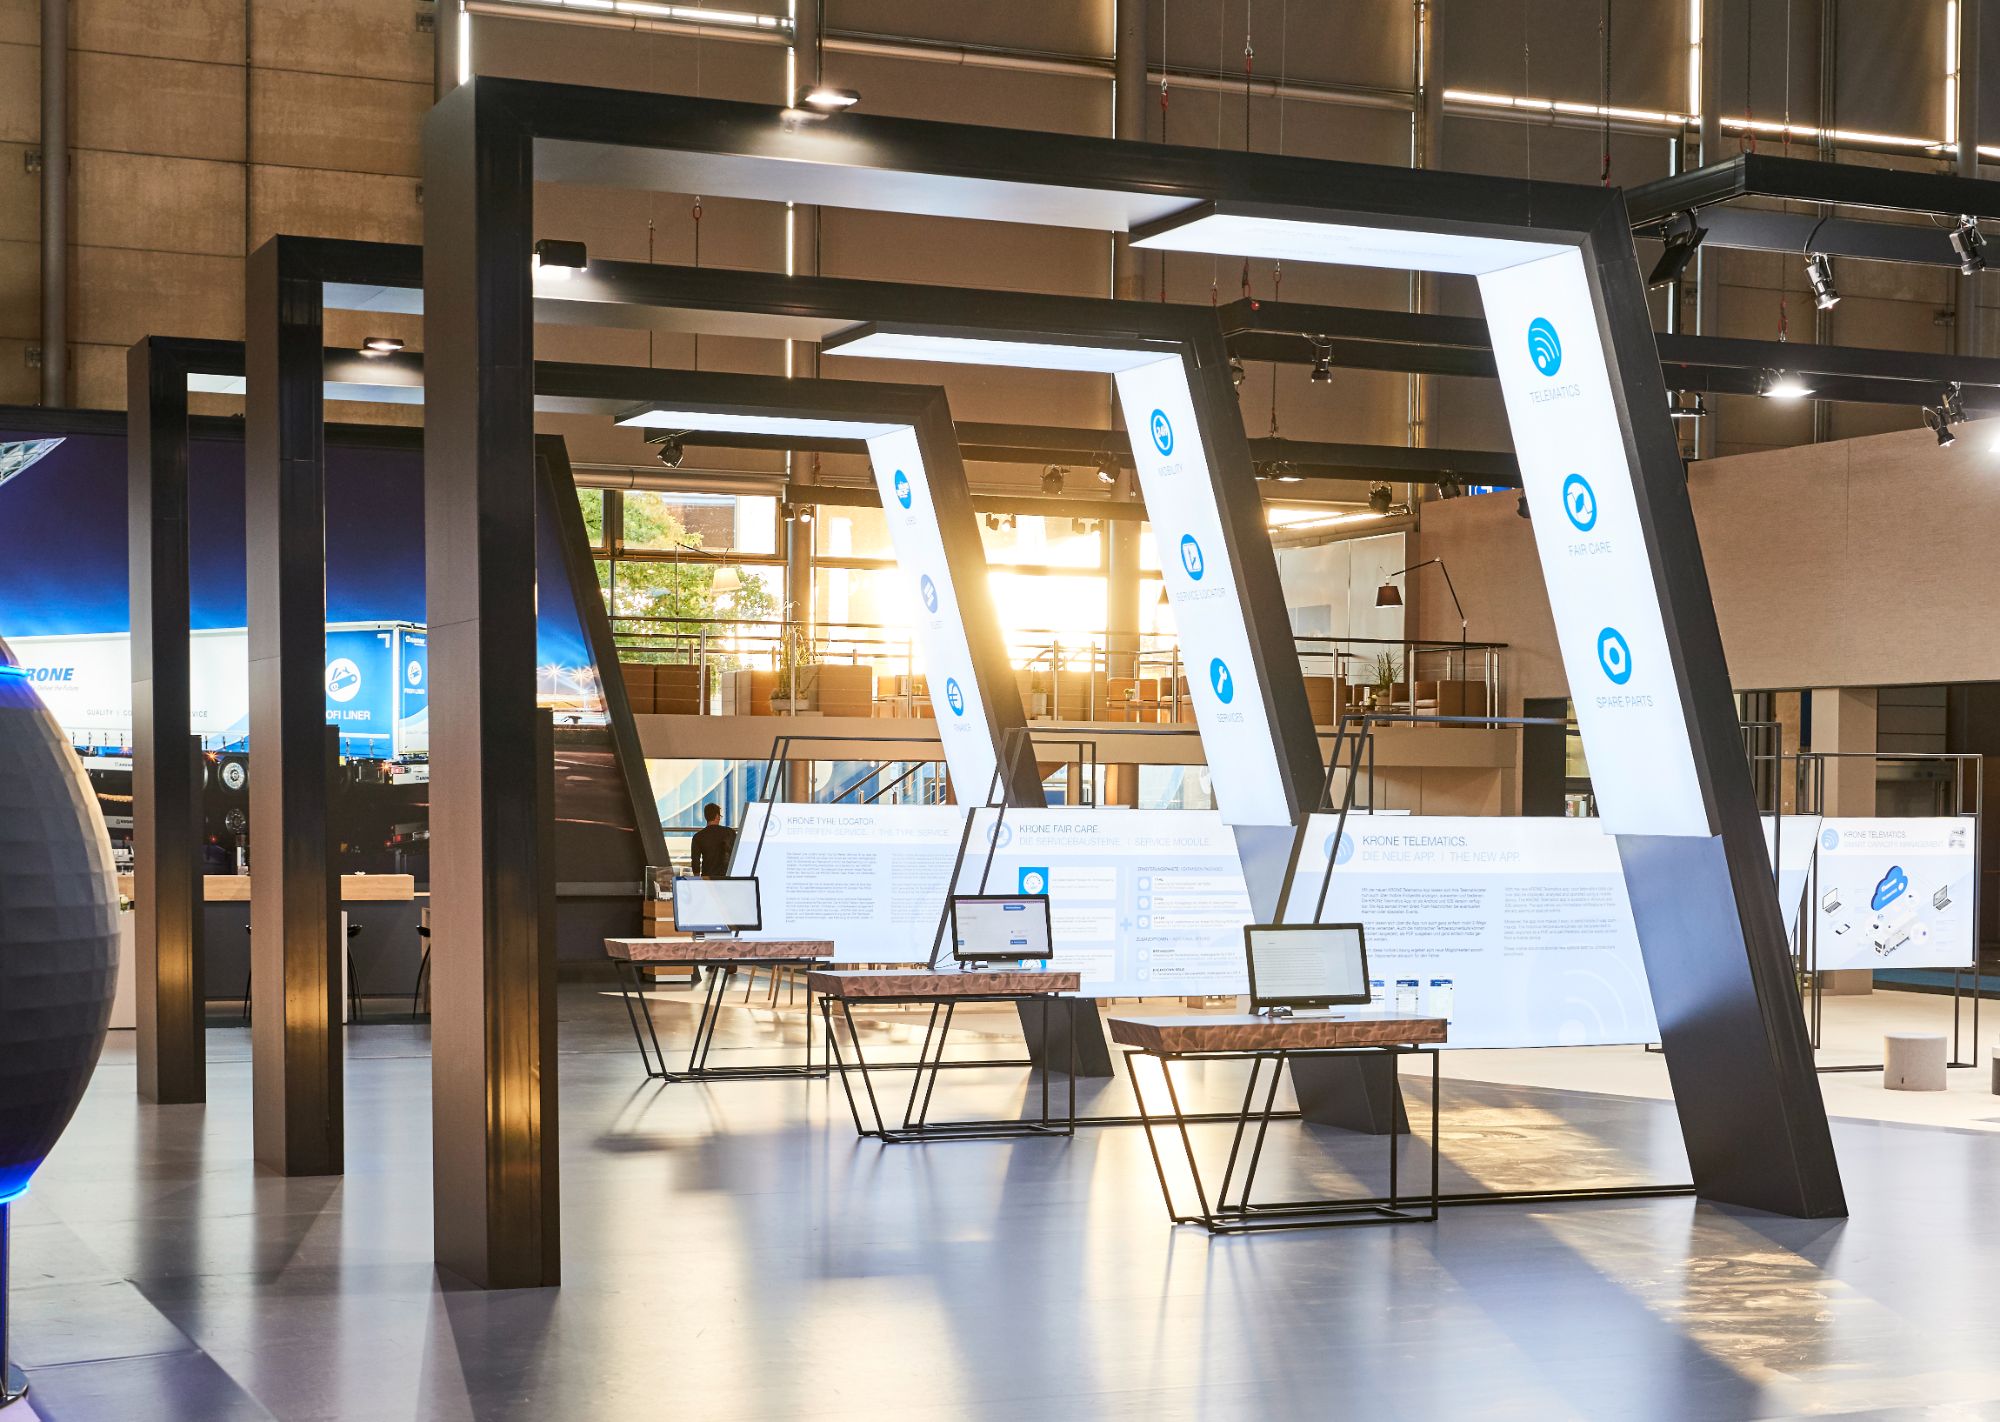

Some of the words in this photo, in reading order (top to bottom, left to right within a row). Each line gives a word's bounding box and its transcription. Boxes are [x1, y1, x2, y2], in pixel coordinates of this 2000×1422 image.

[1529, 384, 1581, 404] TELEMATICS
[1568, 544, 1588, 557] FAIR
[1590, 541, 1612, 554] CARE
[25, 667, 75, 682] RONE
[1595, 696, 1625, 709] SPARE
[1626, 695, 1654, 707] PARTS
[86, 708, 113, 717] QUALITY
[192, 710, 208, 718] VICE
[326, 709, 341, 720] OFI
[343, 710, 371, 720] LINER
[787, 816, 814, 826] KRONE
[1019, 824, 1050, 834] KRONE
[1053, 824, 1073, 834] FAIR
[1844, 829, 1866, 839] KRONE
[1134, 837, 1170, 848] SERVICE
[1362, 835, 1400, 848] KRONE
[1402, 835, 1468, 848] TELEMATICS.
[1362, 850, 1381, 863] DIE
[1381, 850, 1413, 863] NEUE
[1447, 851, 1472, 864] THE
[1472, 851, 1497, 864] NEW
